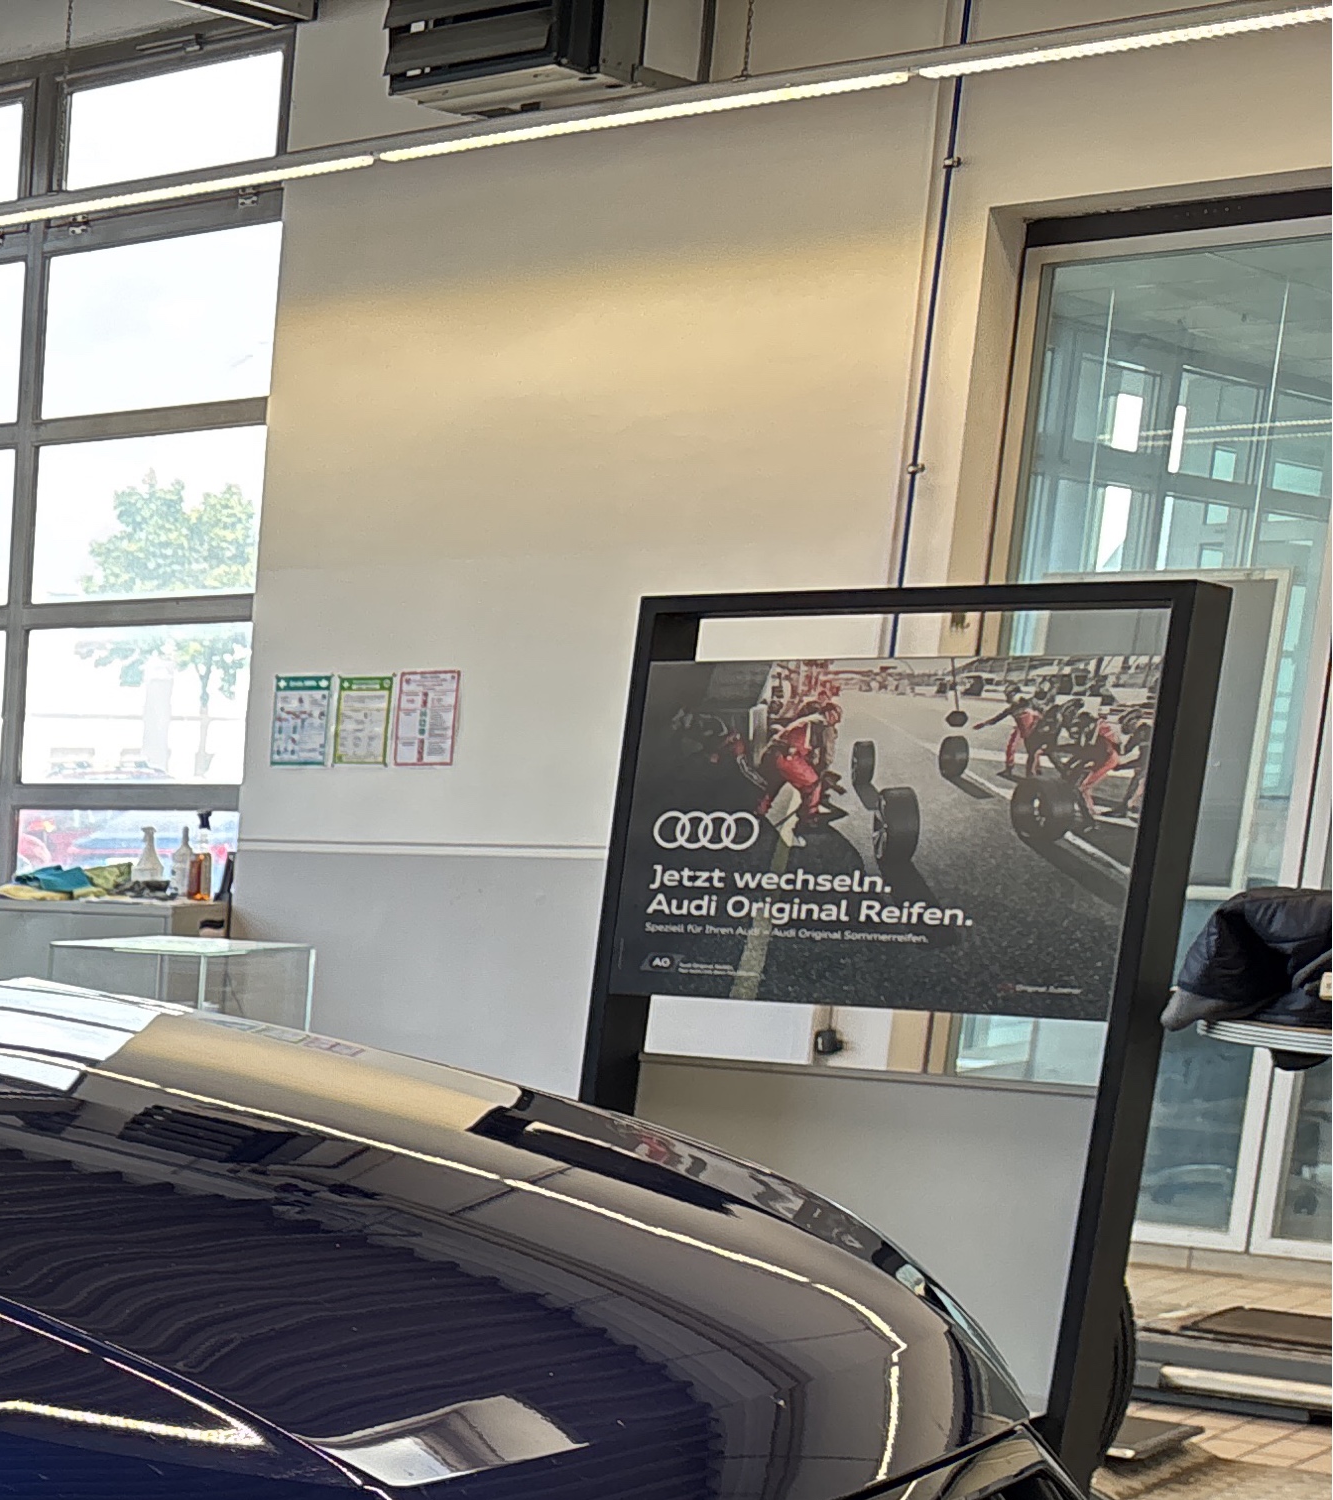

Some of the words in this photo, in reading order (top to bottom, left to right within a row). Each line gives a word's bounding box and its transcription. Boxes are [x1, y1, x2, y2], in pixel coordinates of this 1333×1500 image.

[649, 864, 726, 890] Jetzt
[734, 869, 891, 893] wechseln.
[646, 893, 717, 917] Audi
[726, 895, 849, 924] Original
[859, 900, 973, 926] Reifen.
[771, 927, 796, 938] Audi
[798, 928, 841, 941] Original
